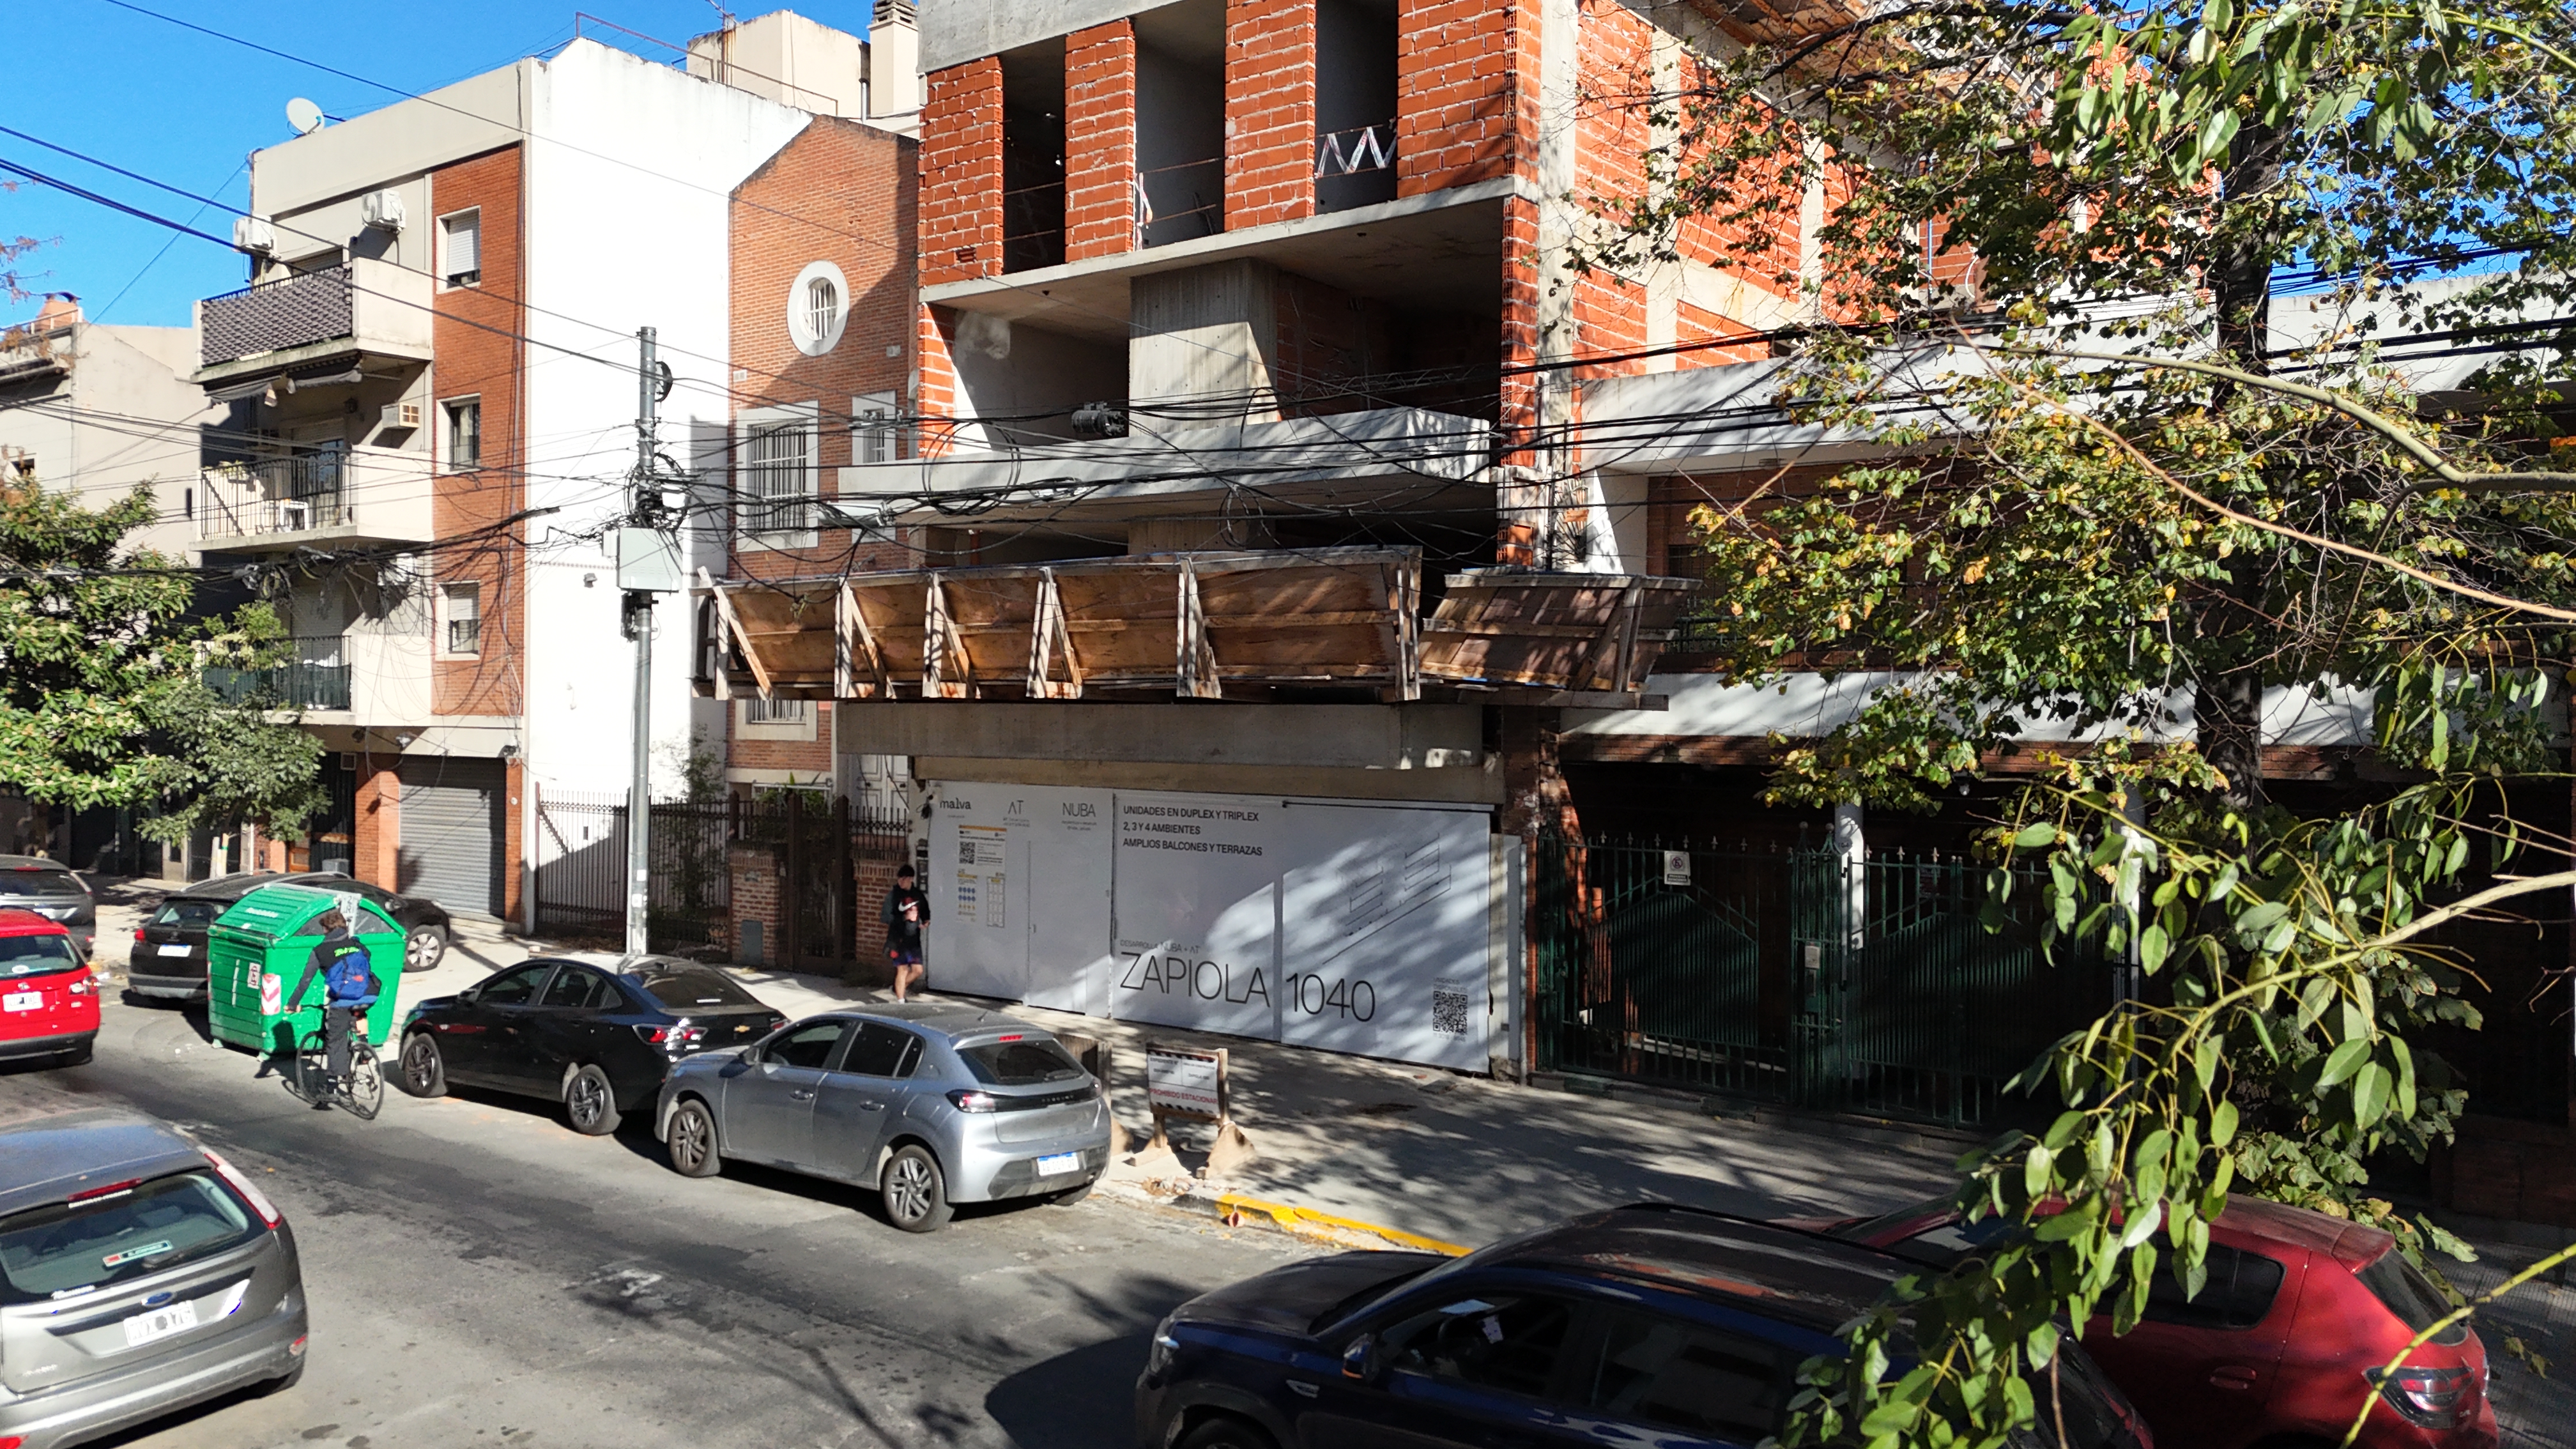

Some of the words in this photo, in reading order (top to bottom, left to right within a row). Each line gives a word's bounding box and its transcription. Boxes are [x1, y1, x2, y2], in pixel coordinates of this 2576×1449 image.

[940, 797, 972, 809] malva
[1062, 802, 1096, 817] NUBA
[1123, 805, 1165, 816] UNIDADES
[1167, 808, 1179, 817] EN
[1181, 808, 1215, 819] DUPLEX
[1214, 811, 1222, 819] Y
[1223, 811, 1259, 822] TRIPLEX
[1123, 822, 1131, 832] 2,
[1132, 822, 1137, 831] 3
[1137, 822, 1144, 831] Y
[1144, 822, 1150, 831] 4
[1151, 823, 1201, 834] AMBIENTES
[1123, 838, 1161, 849] AMPLIOS
[1162, 841, 1208, 852] BALCONES
[1209, 844, 1215, 852] Y
[1216, 844, 1263, 856] TERRAZAS
[1120, 951, 1271, 1008] ZAPIOLA
[1286, 972, 1376, 1022] 1040
[1149, 1087, 1181, 1098] PROHIBIDO
[1181, 1092, 1218, 1104] ESTACIONAR
[164, 1307, 190, 1329] 176
